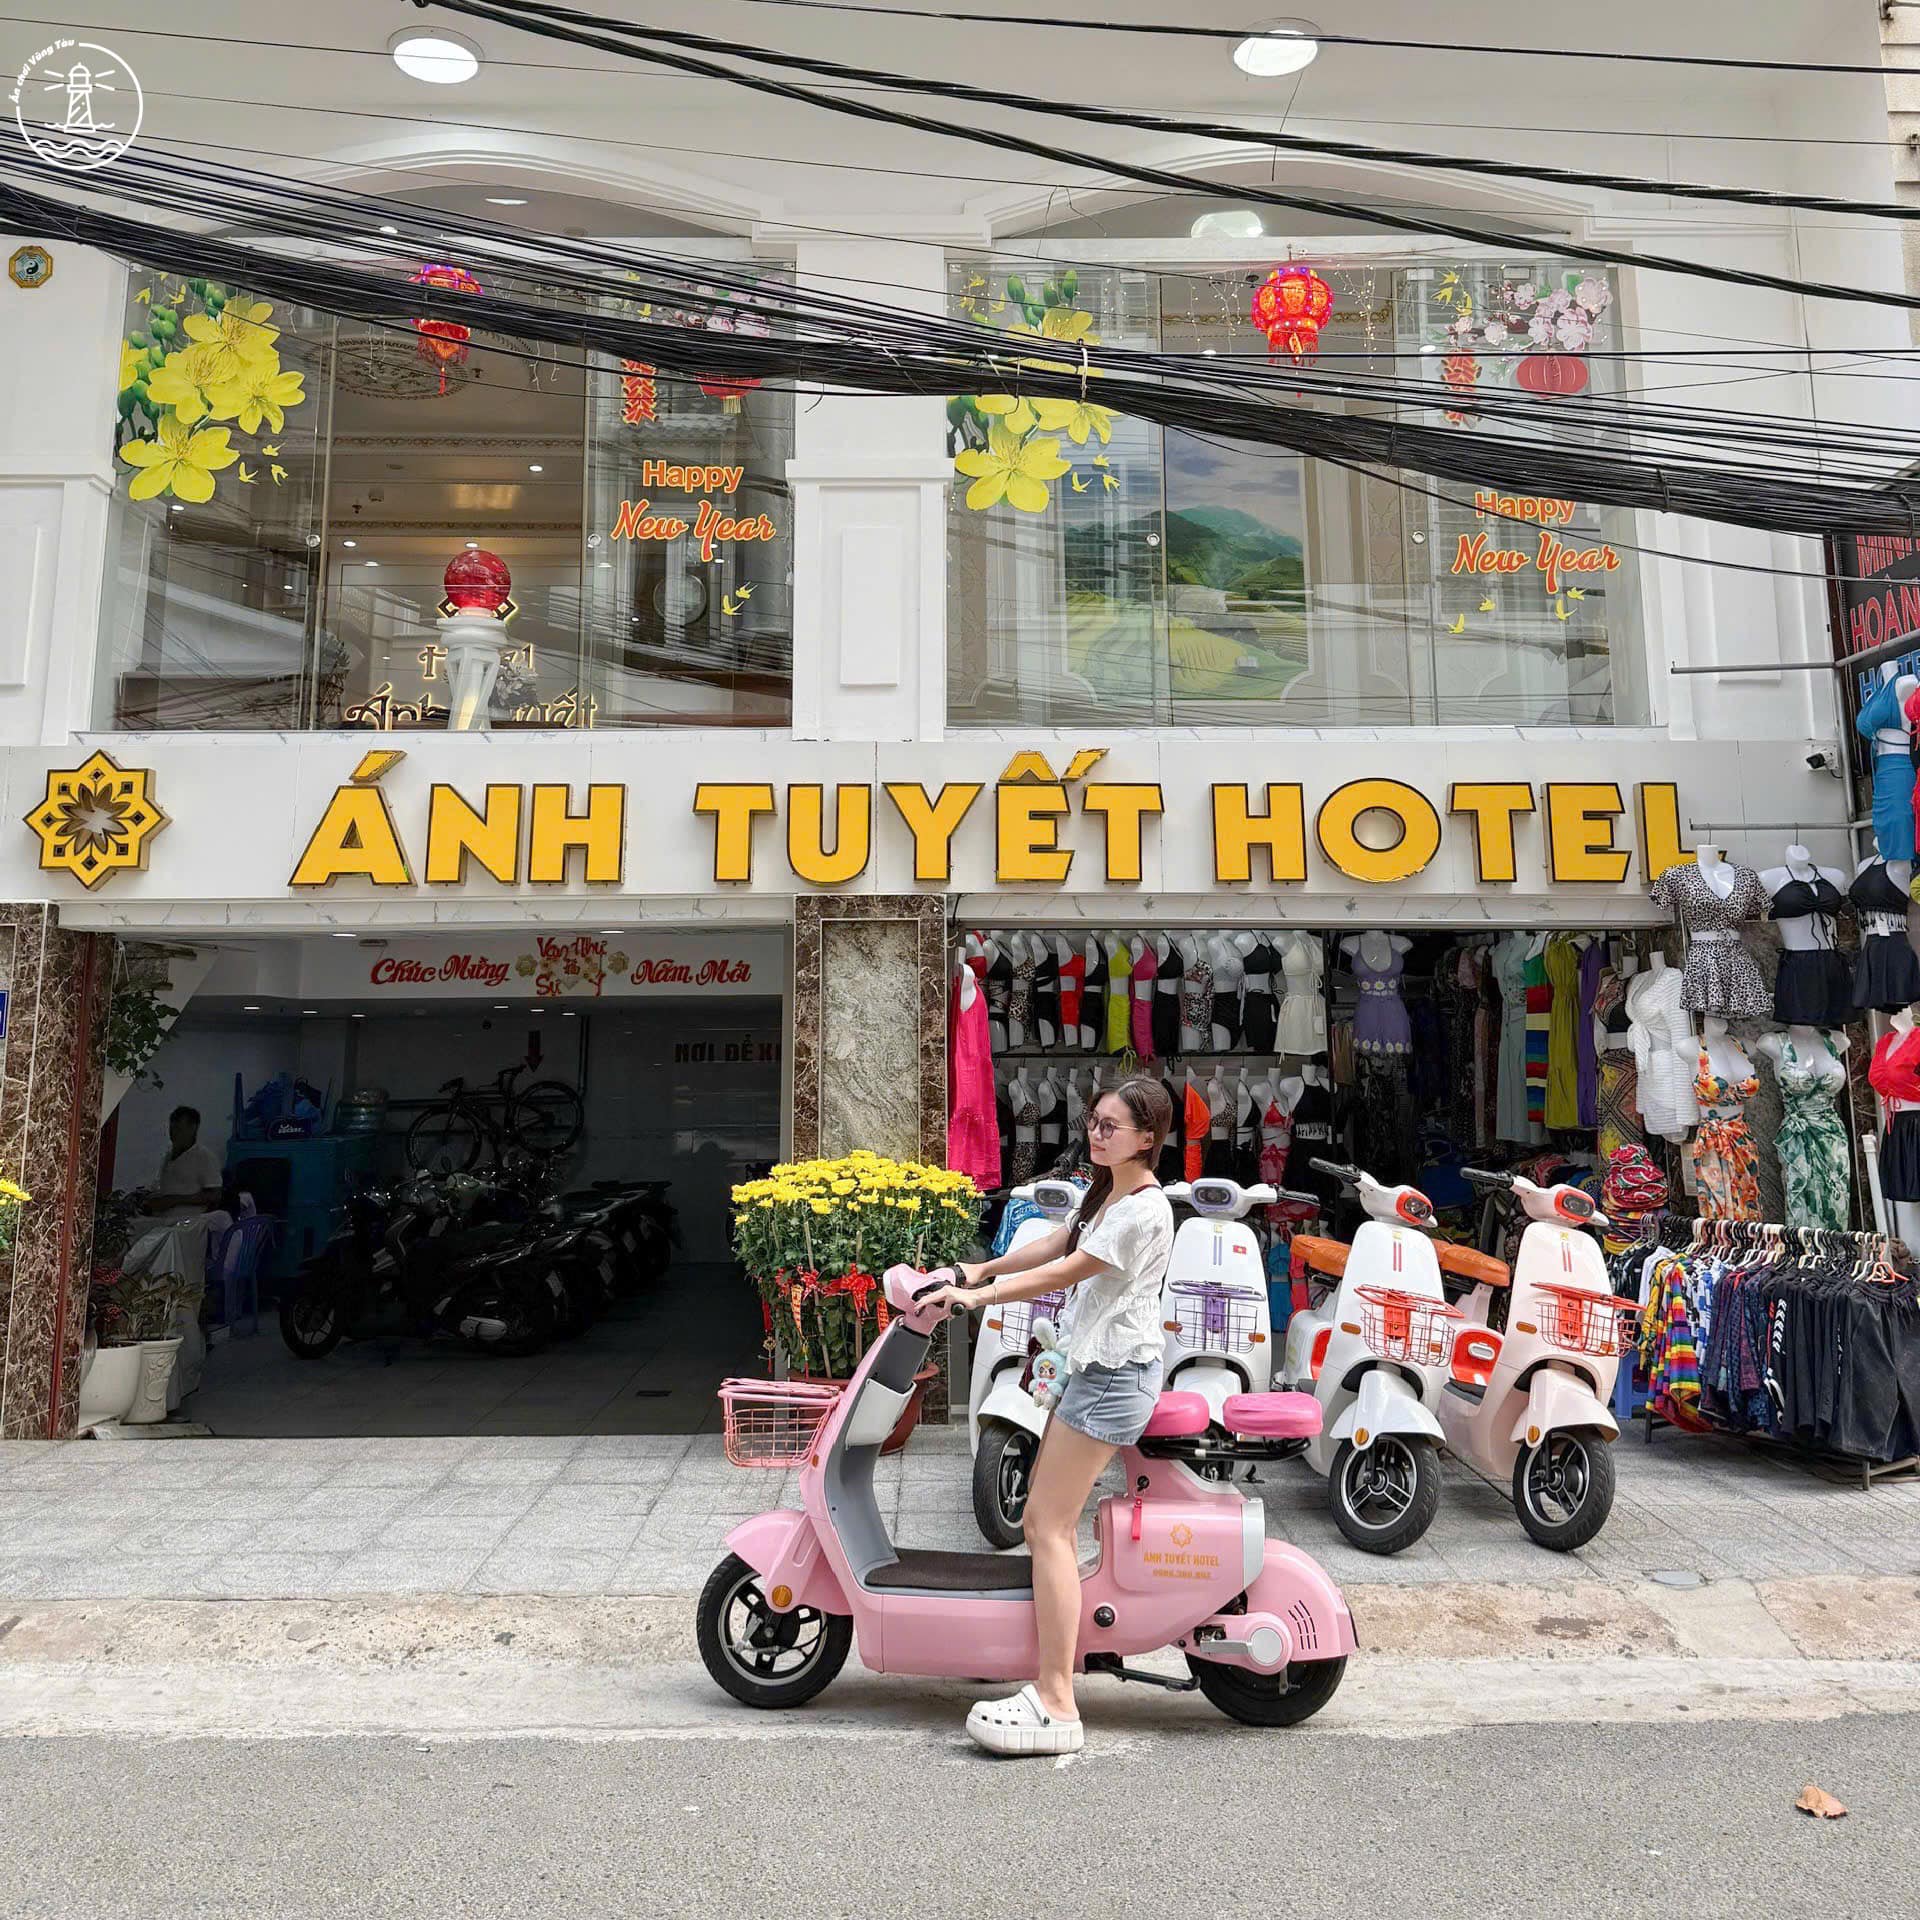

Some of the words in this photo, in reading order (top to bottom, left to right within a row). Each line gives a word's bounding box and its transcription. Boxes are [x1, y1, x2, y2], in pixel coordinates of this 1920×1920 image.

[643, 460, 744, 494] Happy
[1475, 491, 1577, 524] Happy
[611, 499, 689, 540] New
[694, 499, 776, 562] Year
[1451, 531, 1531, 574] New
[1536, 531, 1621, 594] Year
[288, 750, 628, 887] ÁNH
[693, 748, 1166, 888] TUYẾT
[1208, 777, 1727, 884] HOTEL
